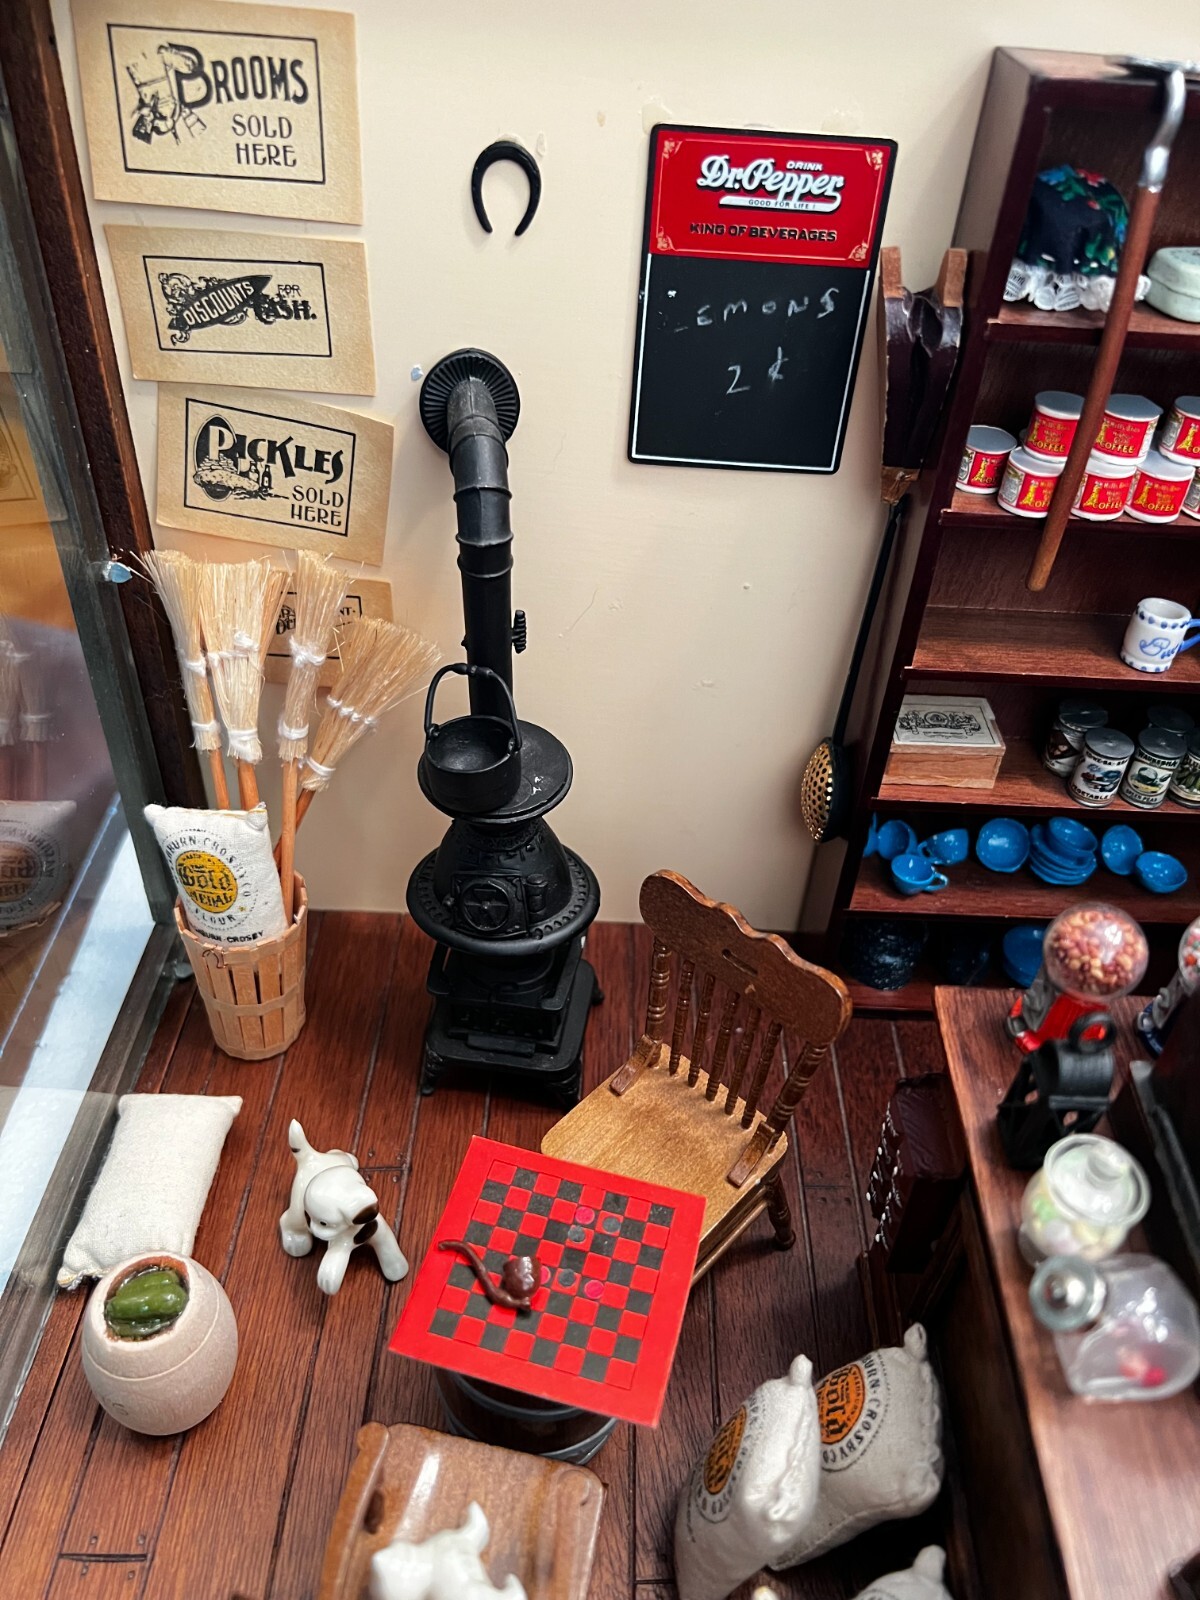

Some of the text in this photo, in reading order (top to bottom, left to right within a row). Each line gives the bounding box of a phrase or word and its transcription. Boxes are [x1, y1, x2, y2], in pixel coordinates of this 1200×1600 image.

[166, 42, 309, 109] BROOMS
[231, 114, 293, 139] SOLD
[236, 143, 297, 168] HERE
[786, 160, 823, 171] DRINK
[748, 199, 771, 207] GOOD
[774, 200, 790, 208] FOR
[690, 223, 837, 241] KING OF BEVERAGES
[277, 284, 302, 297] FOR
[184, 281, 255, 326] DISCOUNTS
[208, 425, 345, 484] PICKLES
[1032, 440, 1066, 453] COFFEE
[1100, 441, 1135, 454] COFFEE
[292, 485, 344, 508] SOLD
[1141, 501, 1176, 512] COFFEE
[291, 504, 342, 527] HERE
